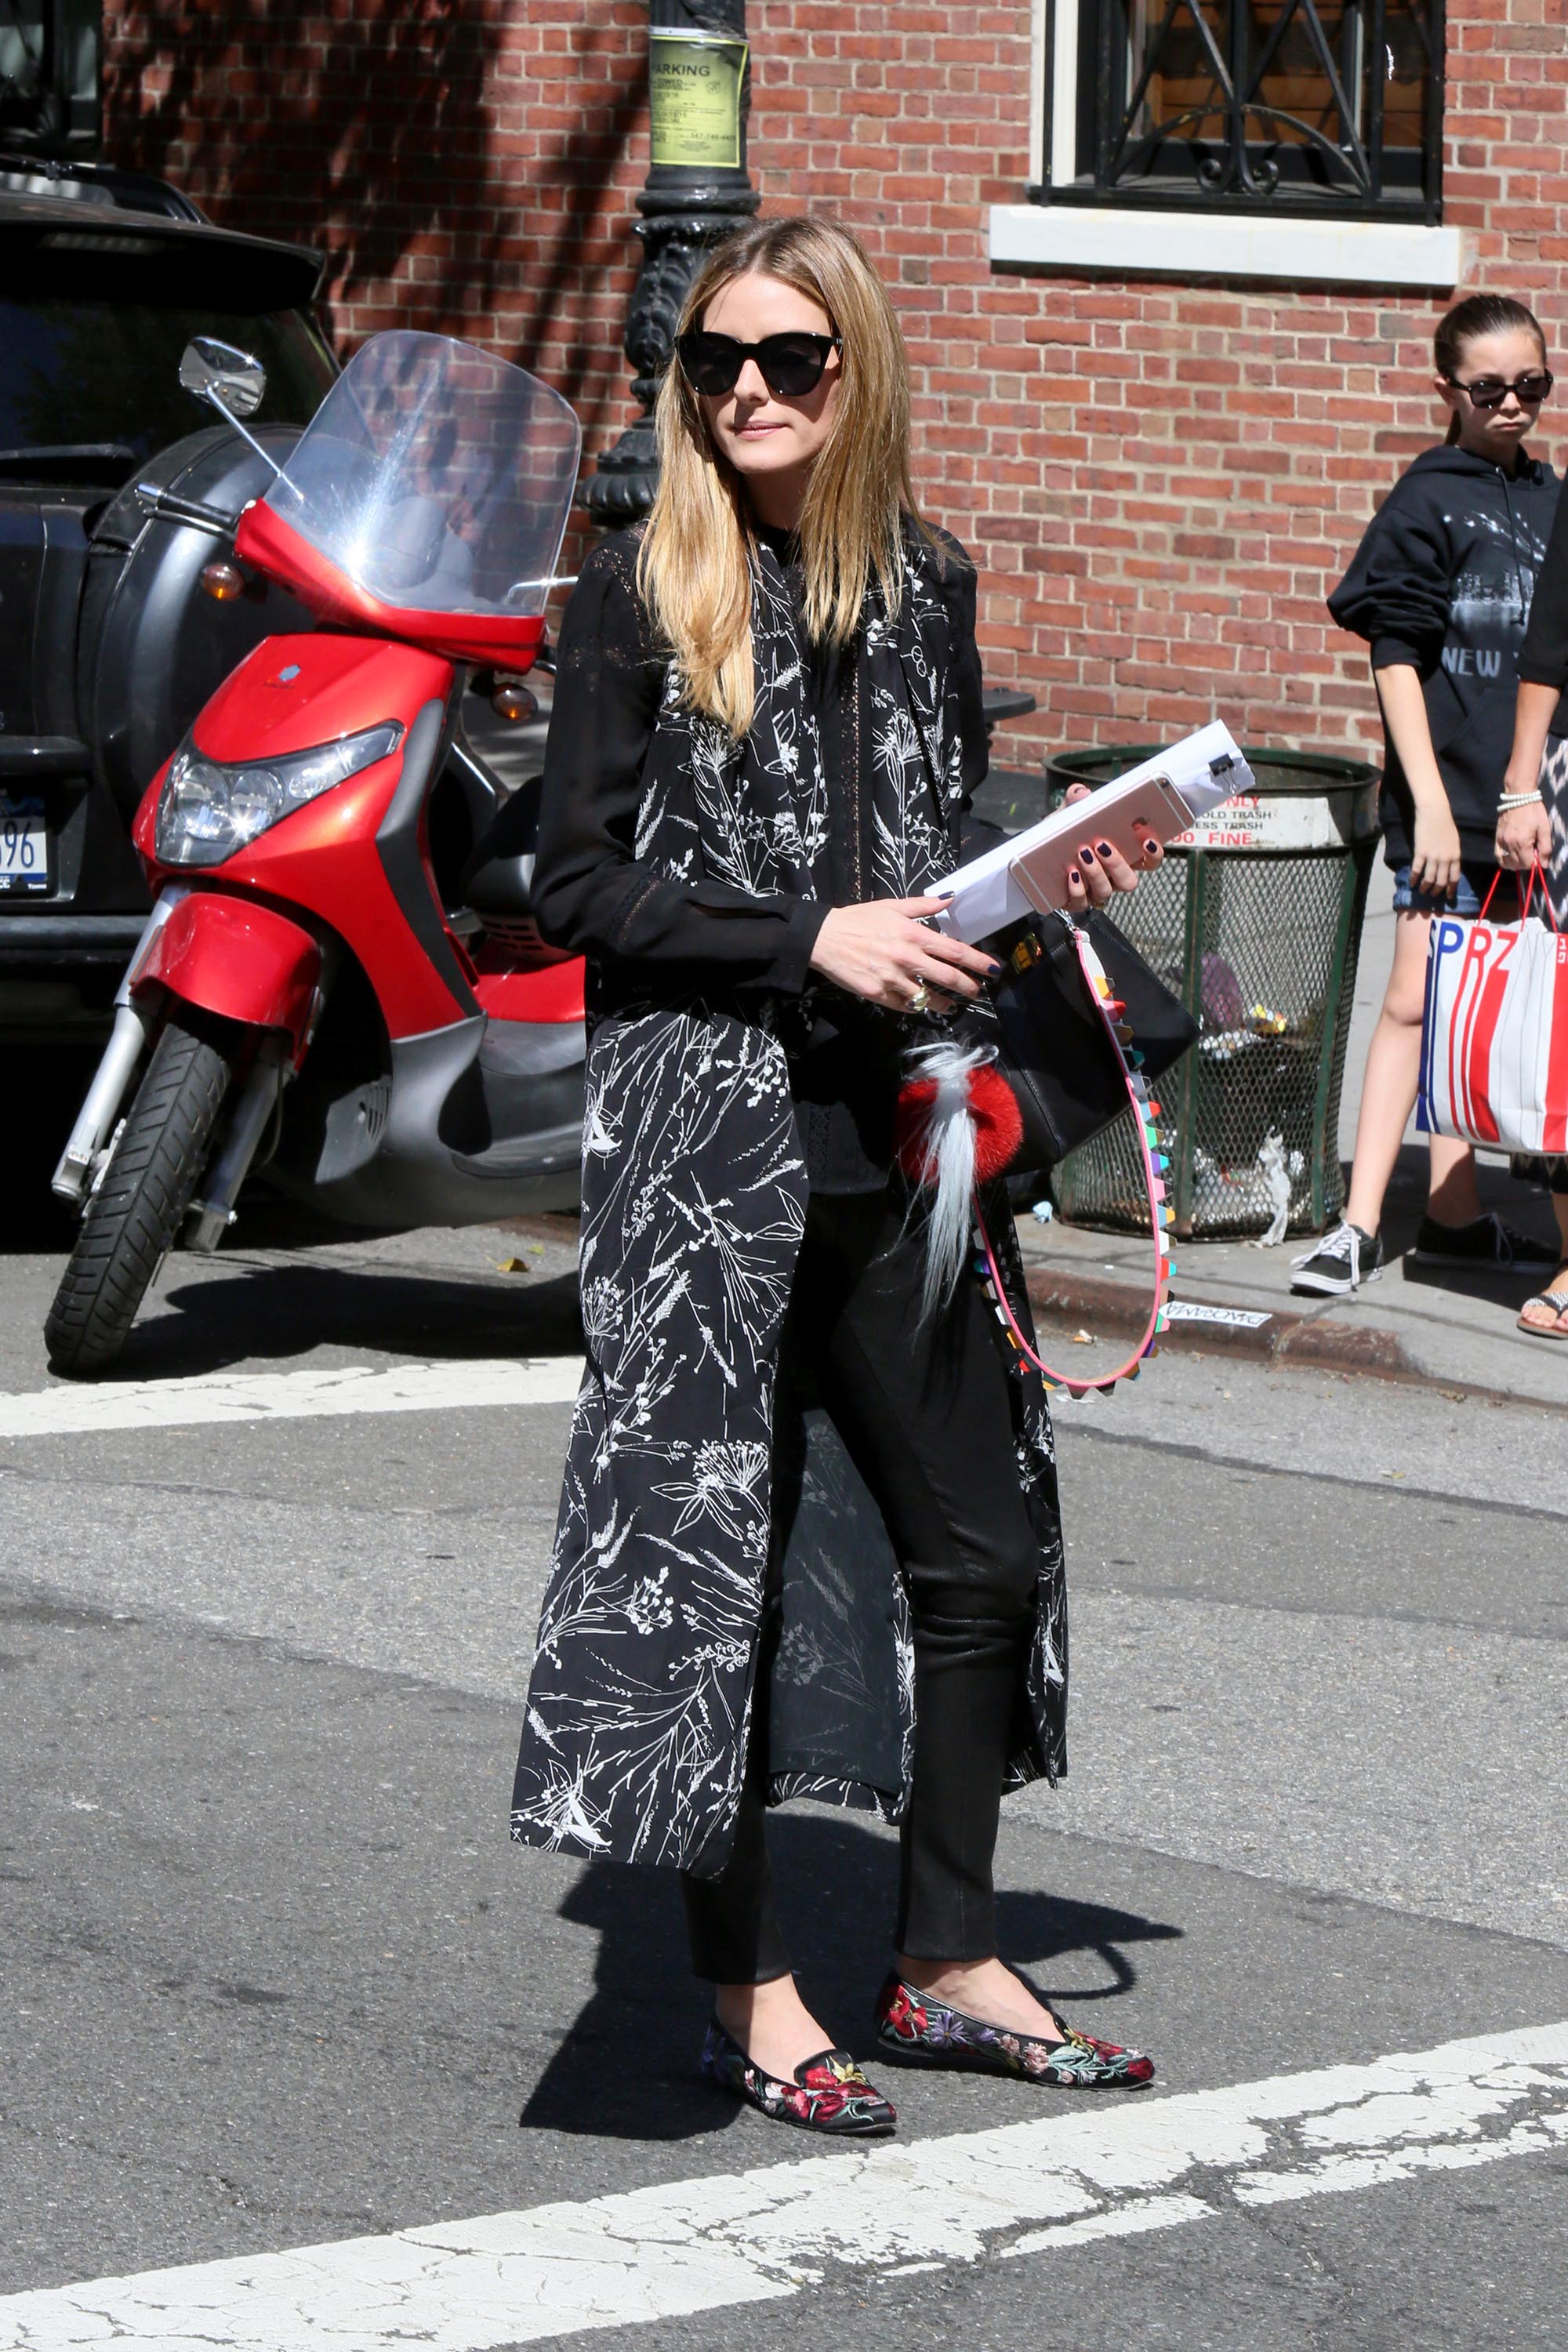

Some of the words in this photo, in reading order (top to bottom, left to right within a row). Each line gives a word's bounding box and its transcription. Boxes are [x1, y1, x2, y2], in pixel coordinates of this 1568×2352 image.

[653, 64, 710, 77] ARKING
[1441, 647, 1501, 678] NEW
[1219, 795, 1259, 809] NLY
[1232, 811, 1272, 820] TRASH
[1224, 822, 1263, 830] TRASH
[0, 820, 34, 868] 96
[1208, 832, 1252, 846] FINE
